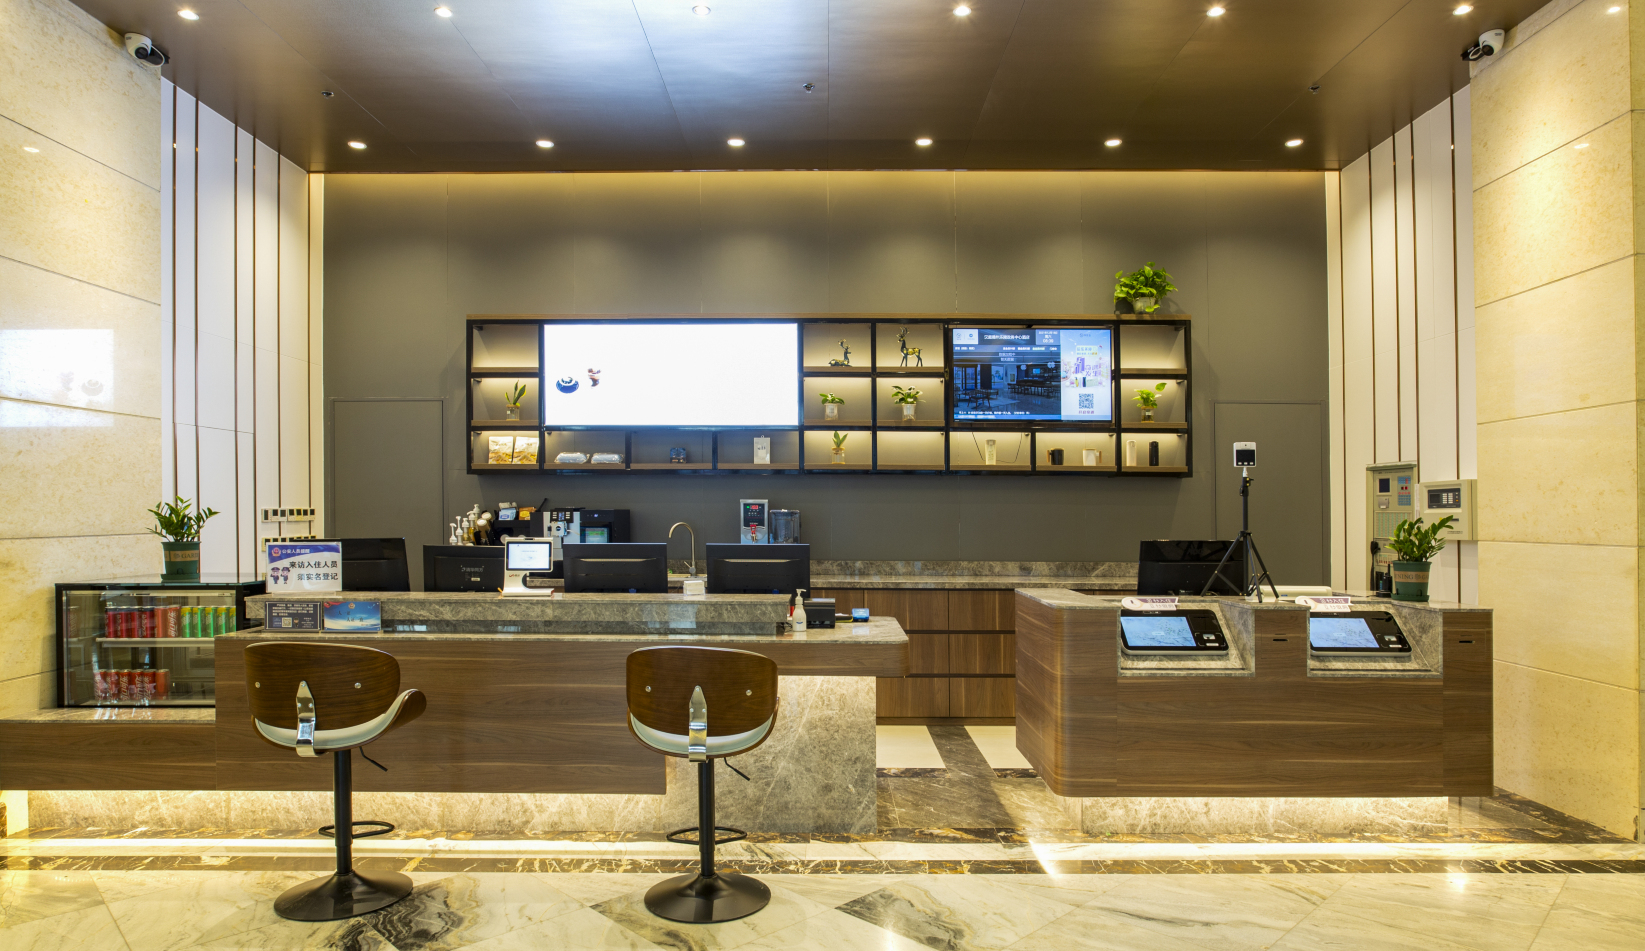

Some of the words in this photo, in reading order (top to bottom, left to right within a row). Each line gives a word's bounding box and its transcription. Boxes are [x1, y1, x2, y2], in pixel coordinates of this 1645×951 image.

[288, 560, 338, 569] 来访入住人员
[297, 572, 339, 581] 须实名登记
